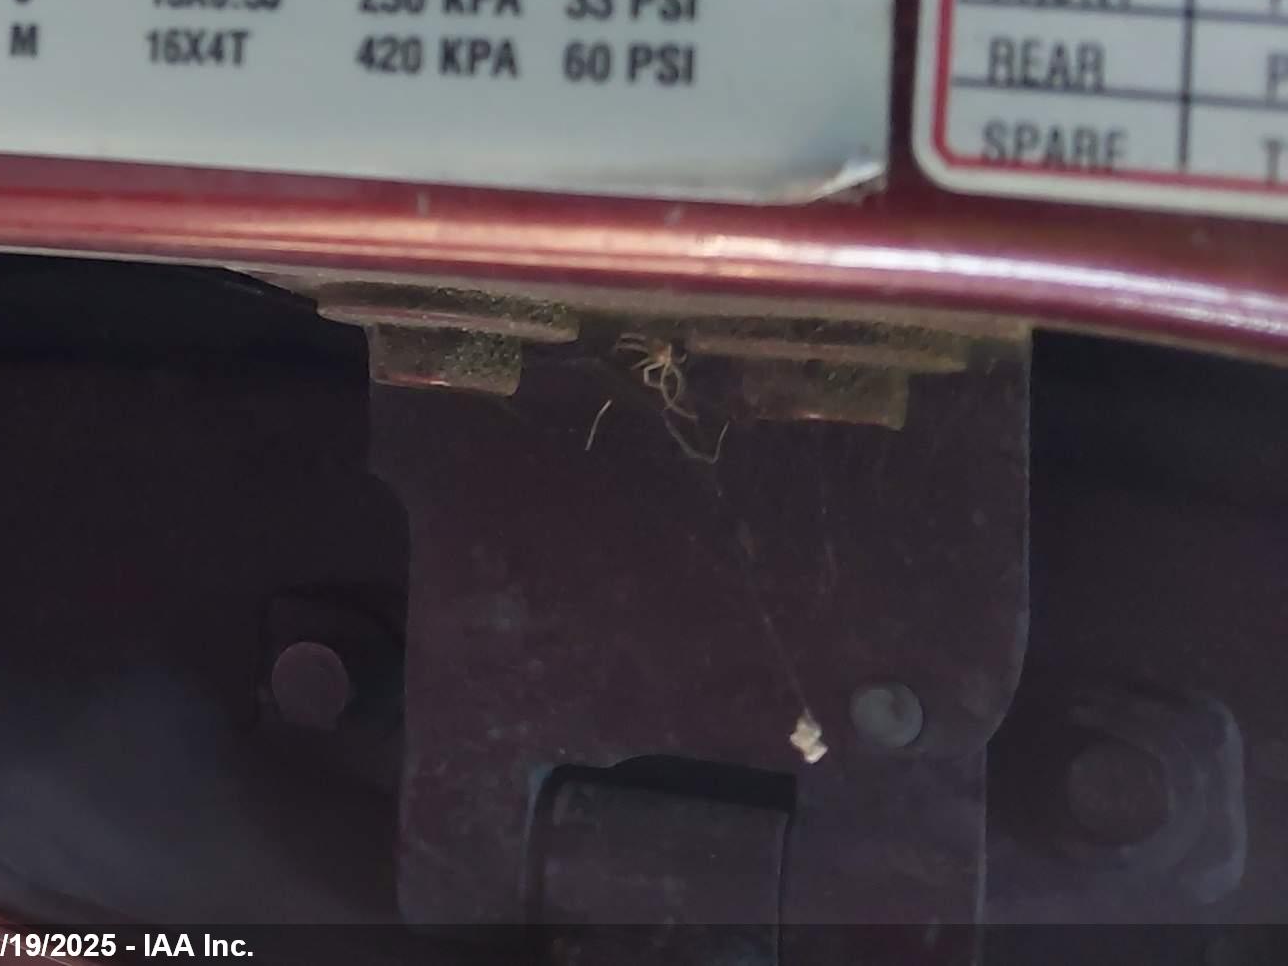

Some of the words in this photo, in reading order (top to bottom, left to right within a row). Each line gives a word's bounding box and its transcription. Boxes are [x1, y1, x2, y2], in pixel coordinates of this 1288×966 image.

[9, 26, 38, 57] M
[147, 30, 251, 66] 16X4T
[356, 36, 423, 75] 420
[439, 38, 518, 78] KPA
[563, 41, 610, 83] 60
[628, 42, 695, 84] PSI
[987, 39, 1105, 92] REAR
